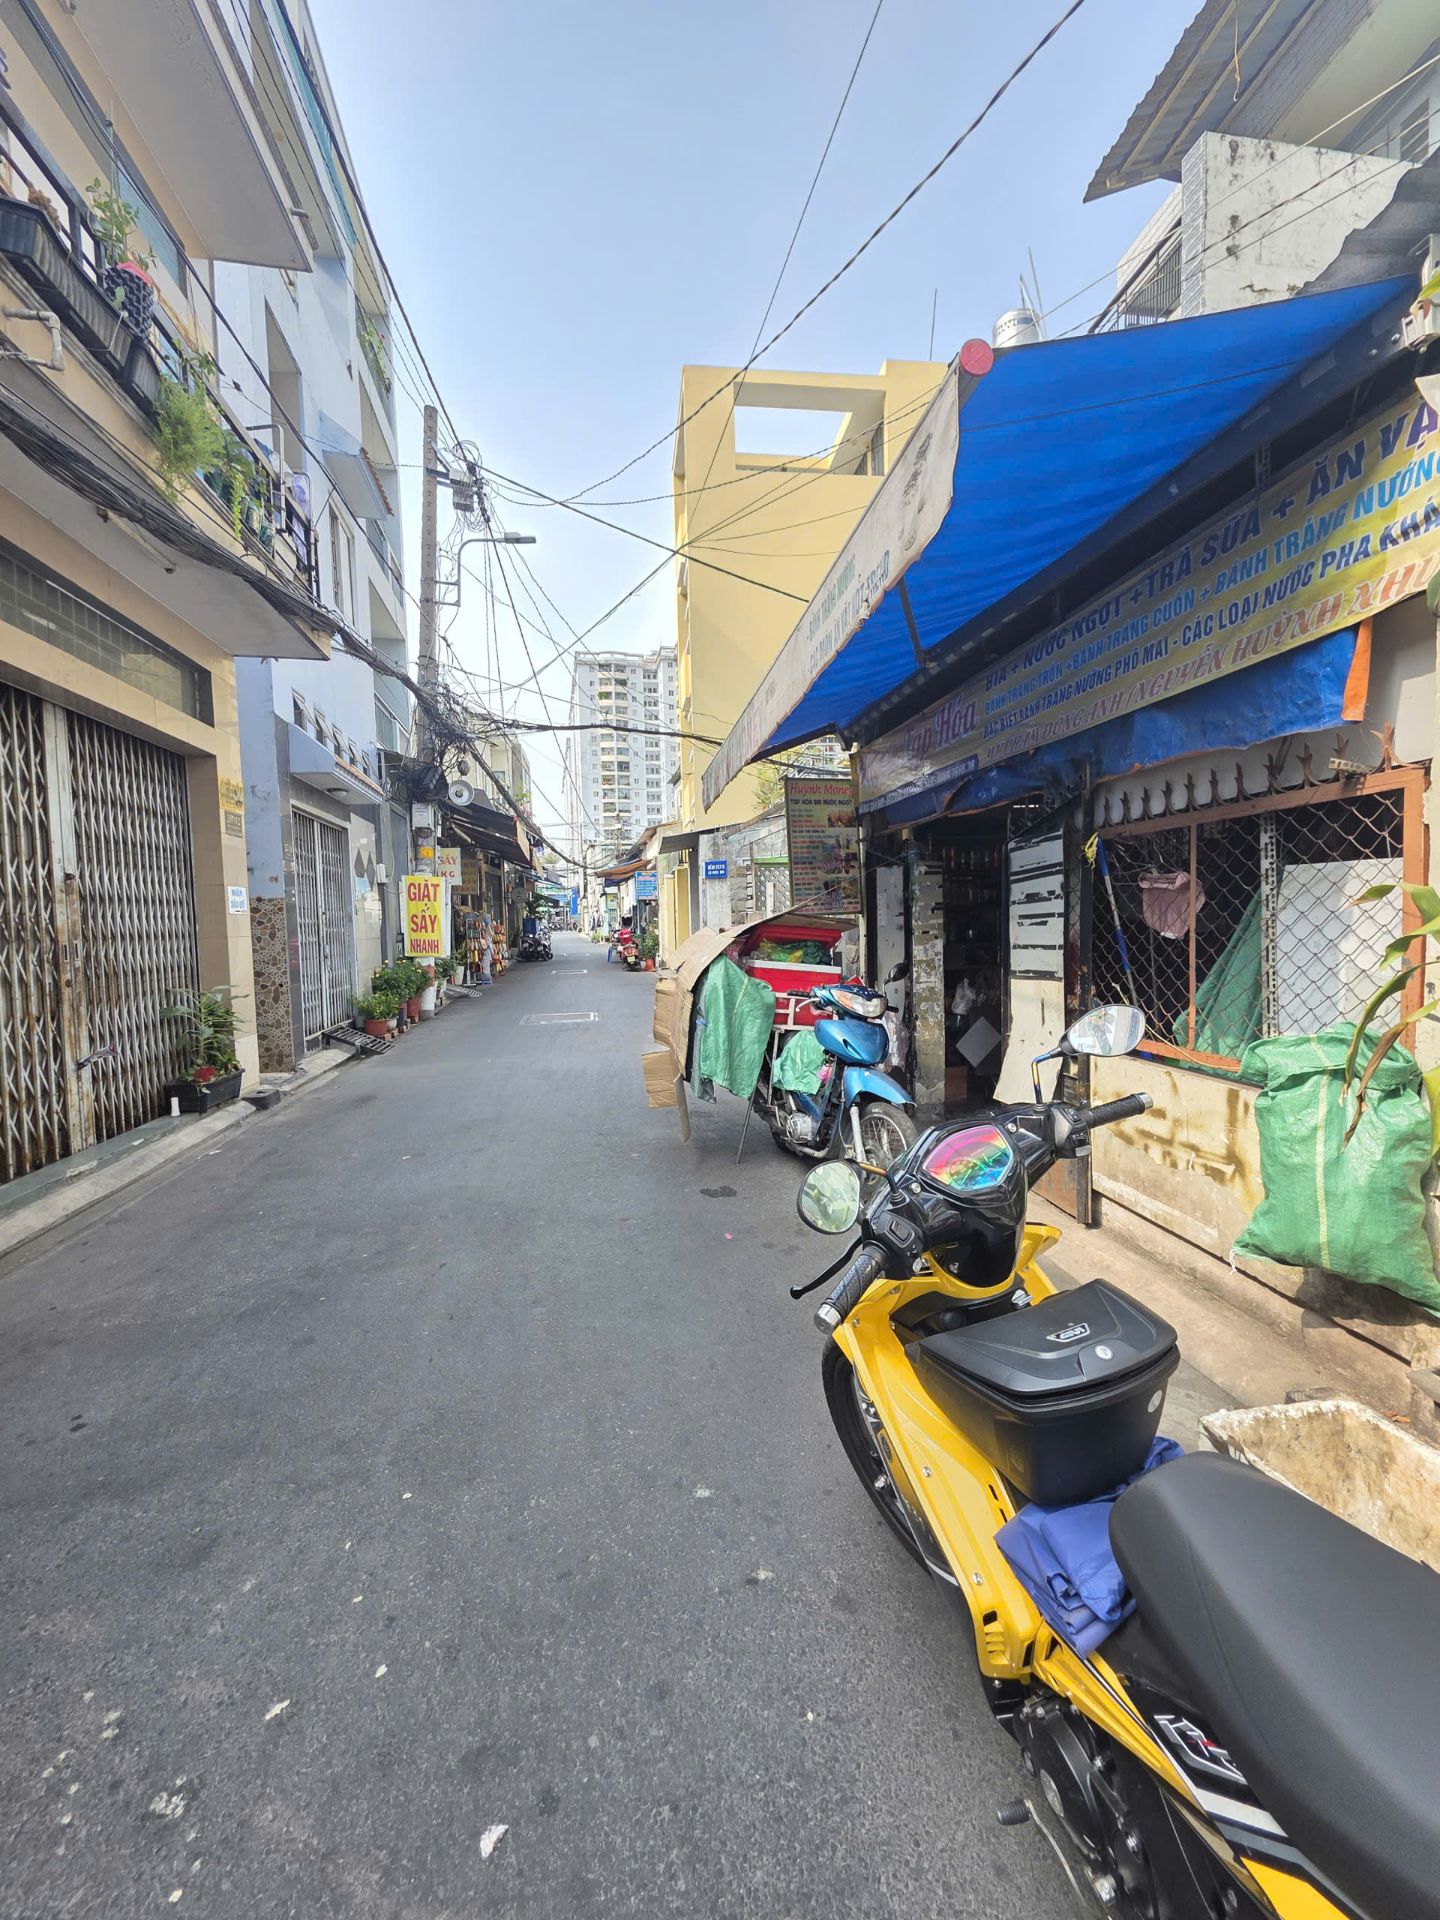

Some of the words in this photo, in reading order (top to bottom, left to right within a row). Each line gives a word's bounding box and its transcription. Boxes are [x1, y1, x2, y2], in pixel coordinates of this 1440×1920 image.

[986, 664, 1008, 691] BIA
[1024, 628, 1068, 669] NƯỚC
[1306, 440, 1366, 505] ĂN
[1380, 395, 1438, 460] VẶ
[1215, 548, 1268, 596] BÁNH
[1273, 502, 1348, 565] TRÁNG
[1142, 635, 1169, 666] MAI
[1182, 613, 1213, 647] CÁC
[1218, 591, 1259, 631] LOẠI
[1263, 560, 1315, 609] NƯỚC
[1319, 534, 1371, 580] PHA
[408, 879, 440, 909] GIẶT
[410, 905, 438, 933] SẤY
[410, 938, 439, 954] NHANH
